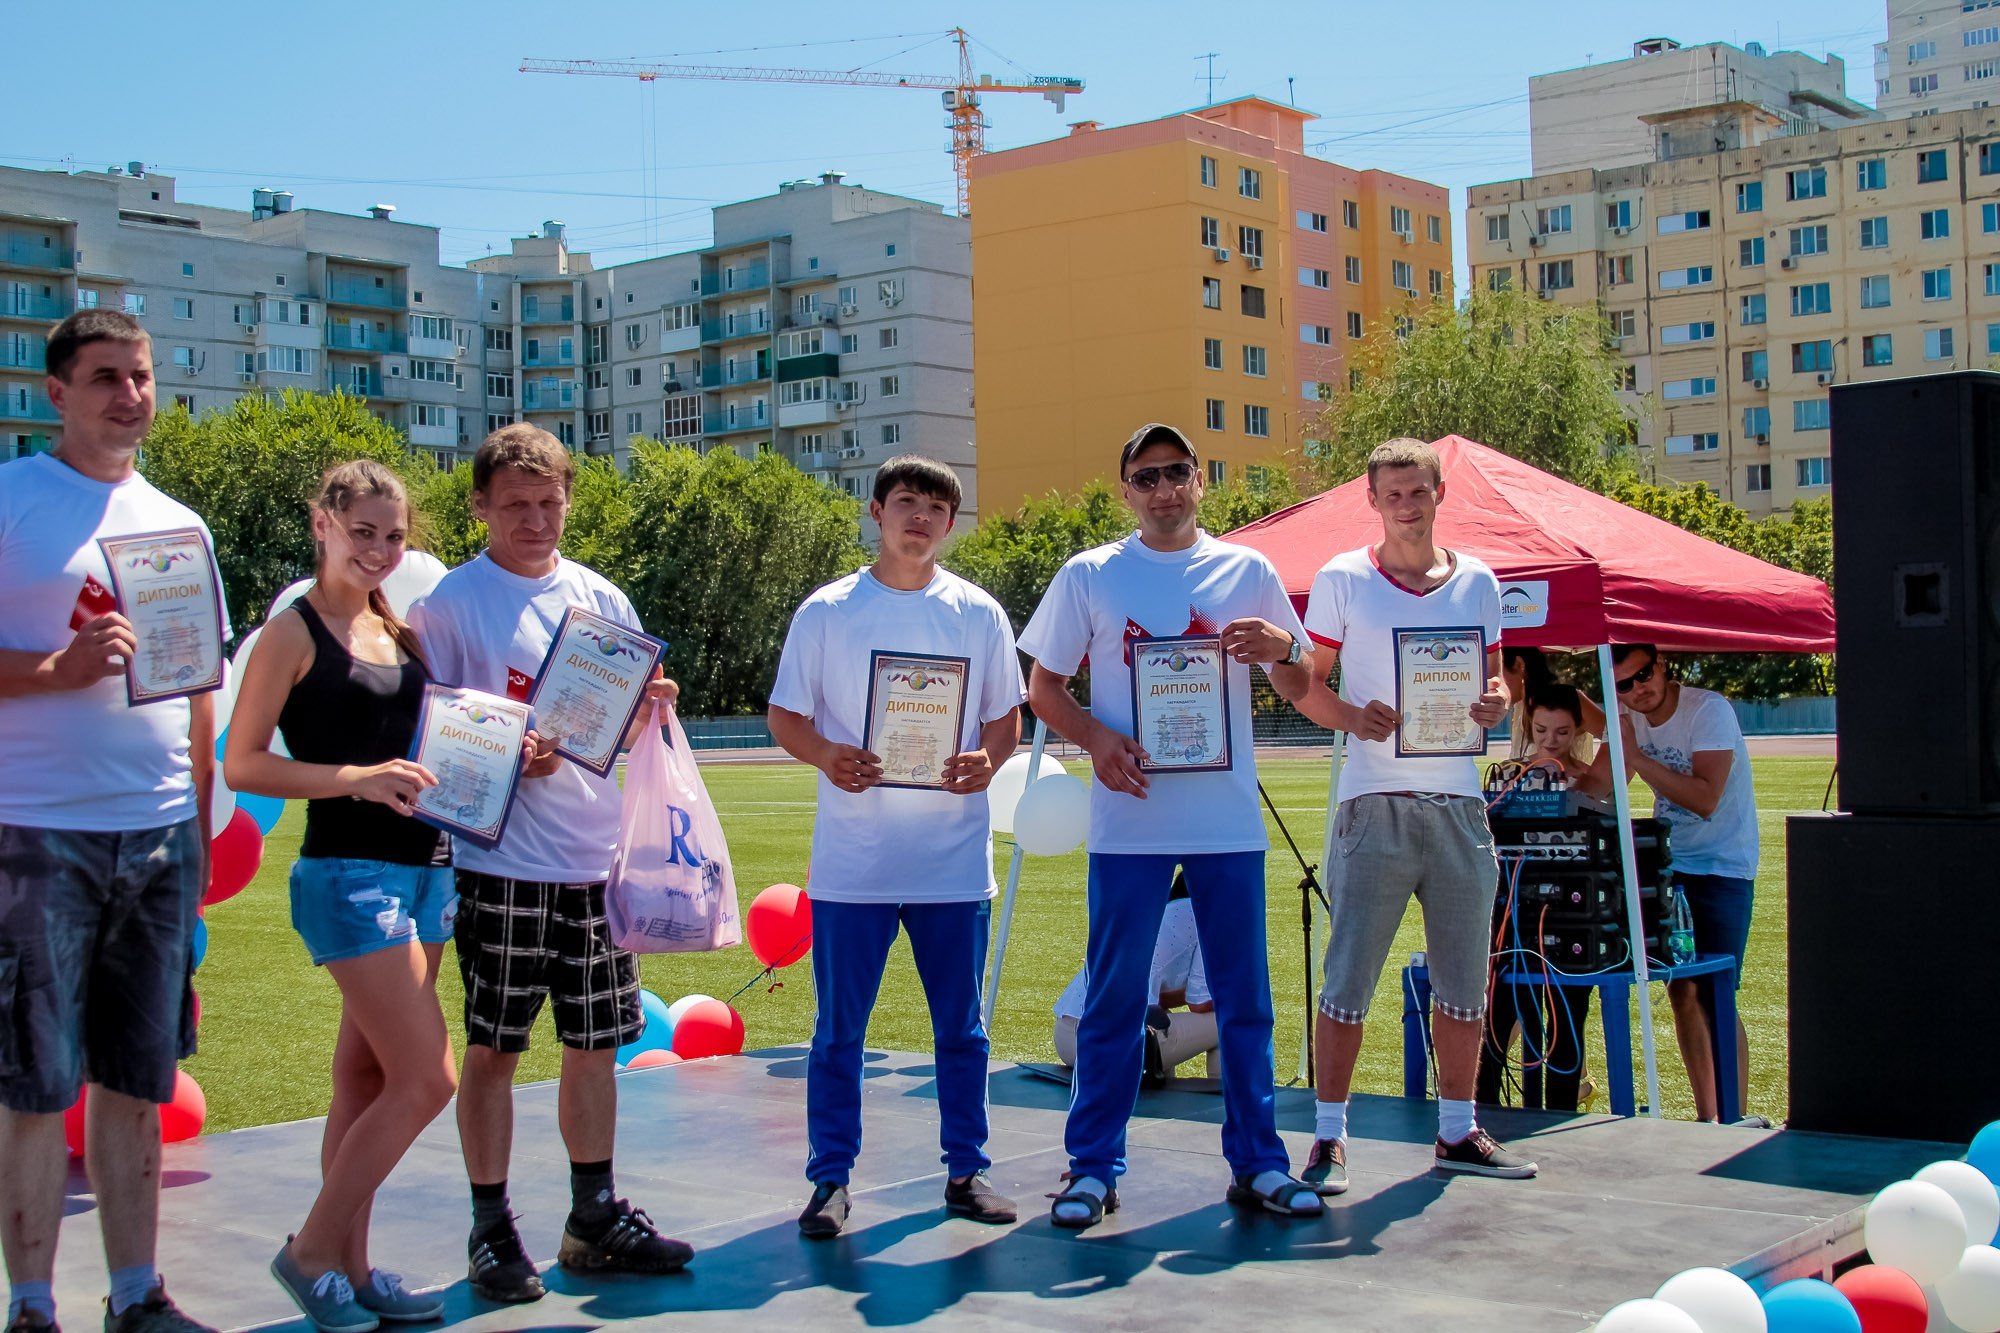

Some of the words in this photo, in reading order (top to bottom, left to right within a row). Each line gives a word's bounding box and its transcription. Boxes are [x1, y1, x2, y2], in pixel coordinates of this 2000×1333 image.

[1033, 76, 1073, 84] ZOOMLION
[137, 583, 203, 607] ДИПЛОМ
[565, 652, 631, 691] ДИПЛОМ
[1413, 671, 1471, 685] ДИПЛОМ
[1150, 682, 1211, 698] ДИПЛОМ
[886, 700, 948, 715] ДИПЛОМ
[440, 725, 507, 757] ДИПЛОМ
[1515, 793, 1560, 803] Soundcraft
